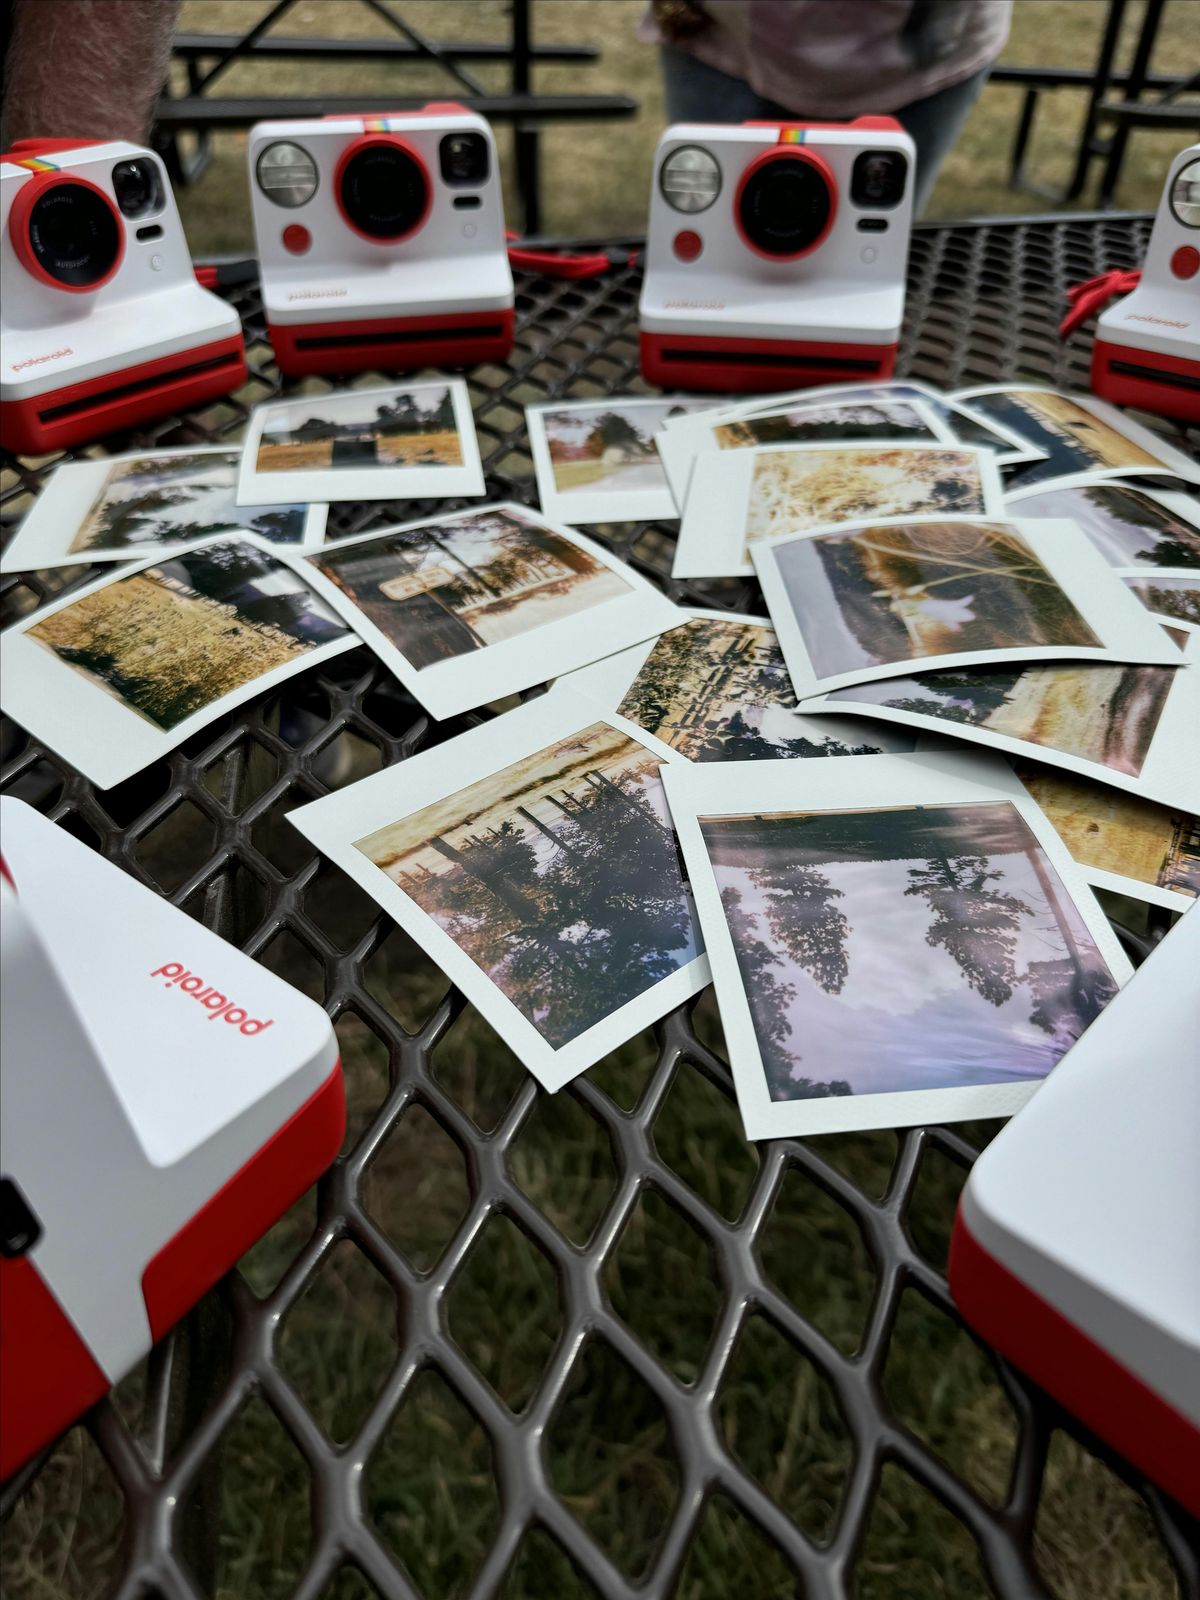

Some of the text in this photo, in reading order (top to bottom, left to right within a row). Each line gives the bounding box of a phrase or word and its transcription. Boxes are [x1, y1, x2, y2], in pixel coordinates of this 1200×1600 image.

[1125, 313, 1190, 329] polaroid
[11, 346, 73, 373] polaroid
[150, 962, 275, 1036] polaroid
